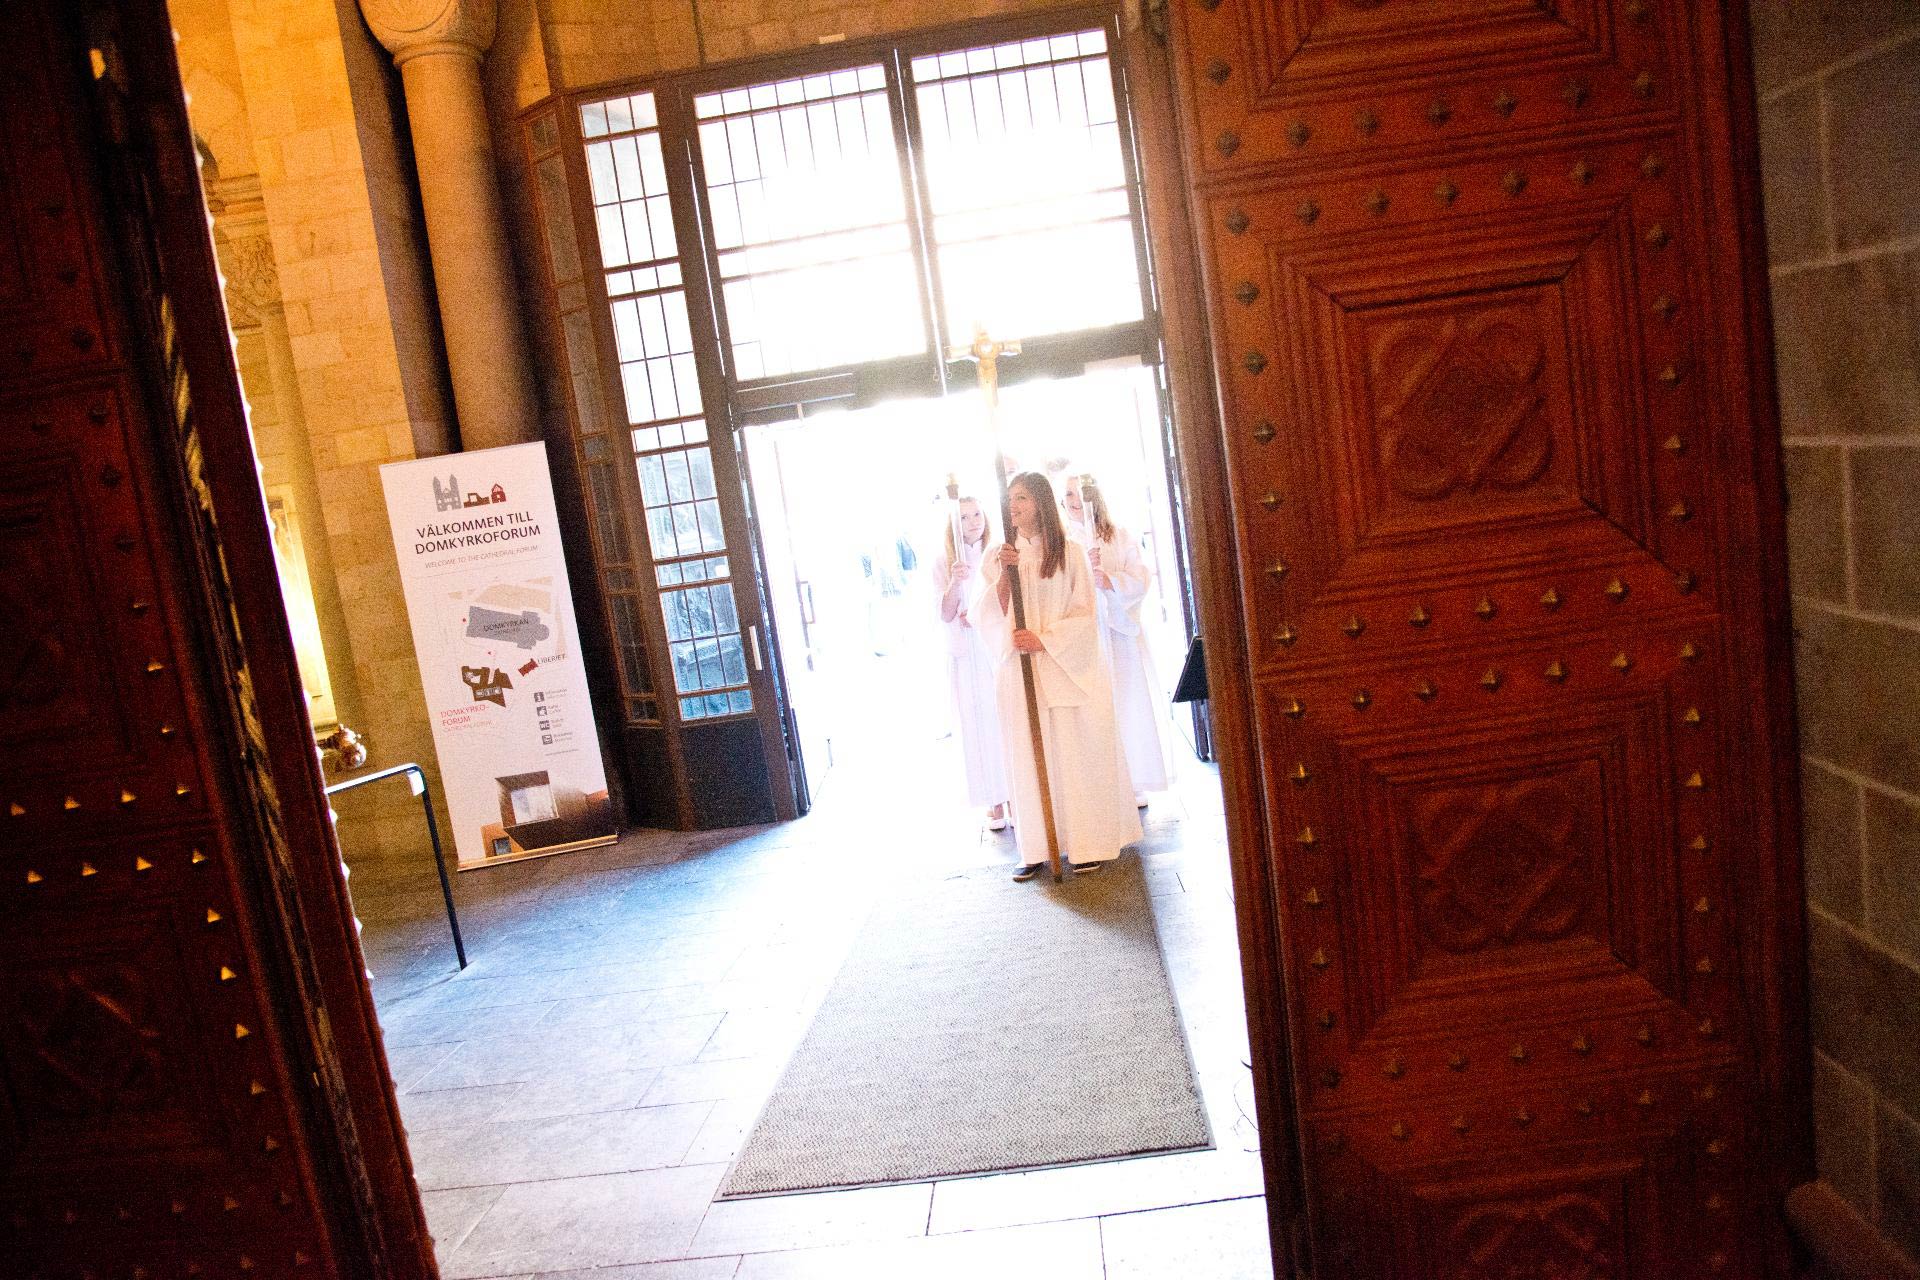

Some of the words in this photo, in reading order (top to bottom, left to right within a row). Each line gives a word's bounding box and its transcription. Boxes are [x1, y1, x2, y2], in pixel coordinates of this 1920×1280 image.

[417, 515, 504, 538] VÄLKOMMEN
[507, 511, 534, 524] TILL
[415, 525, 541, 554] DOMKYRKOFORUM
[425, 558, 456, 569] WELCOME
[468, 554, 479, 562] THE
[516, 545, 538, 555] FORUM
[442, 715, 471, 726] FORUM
